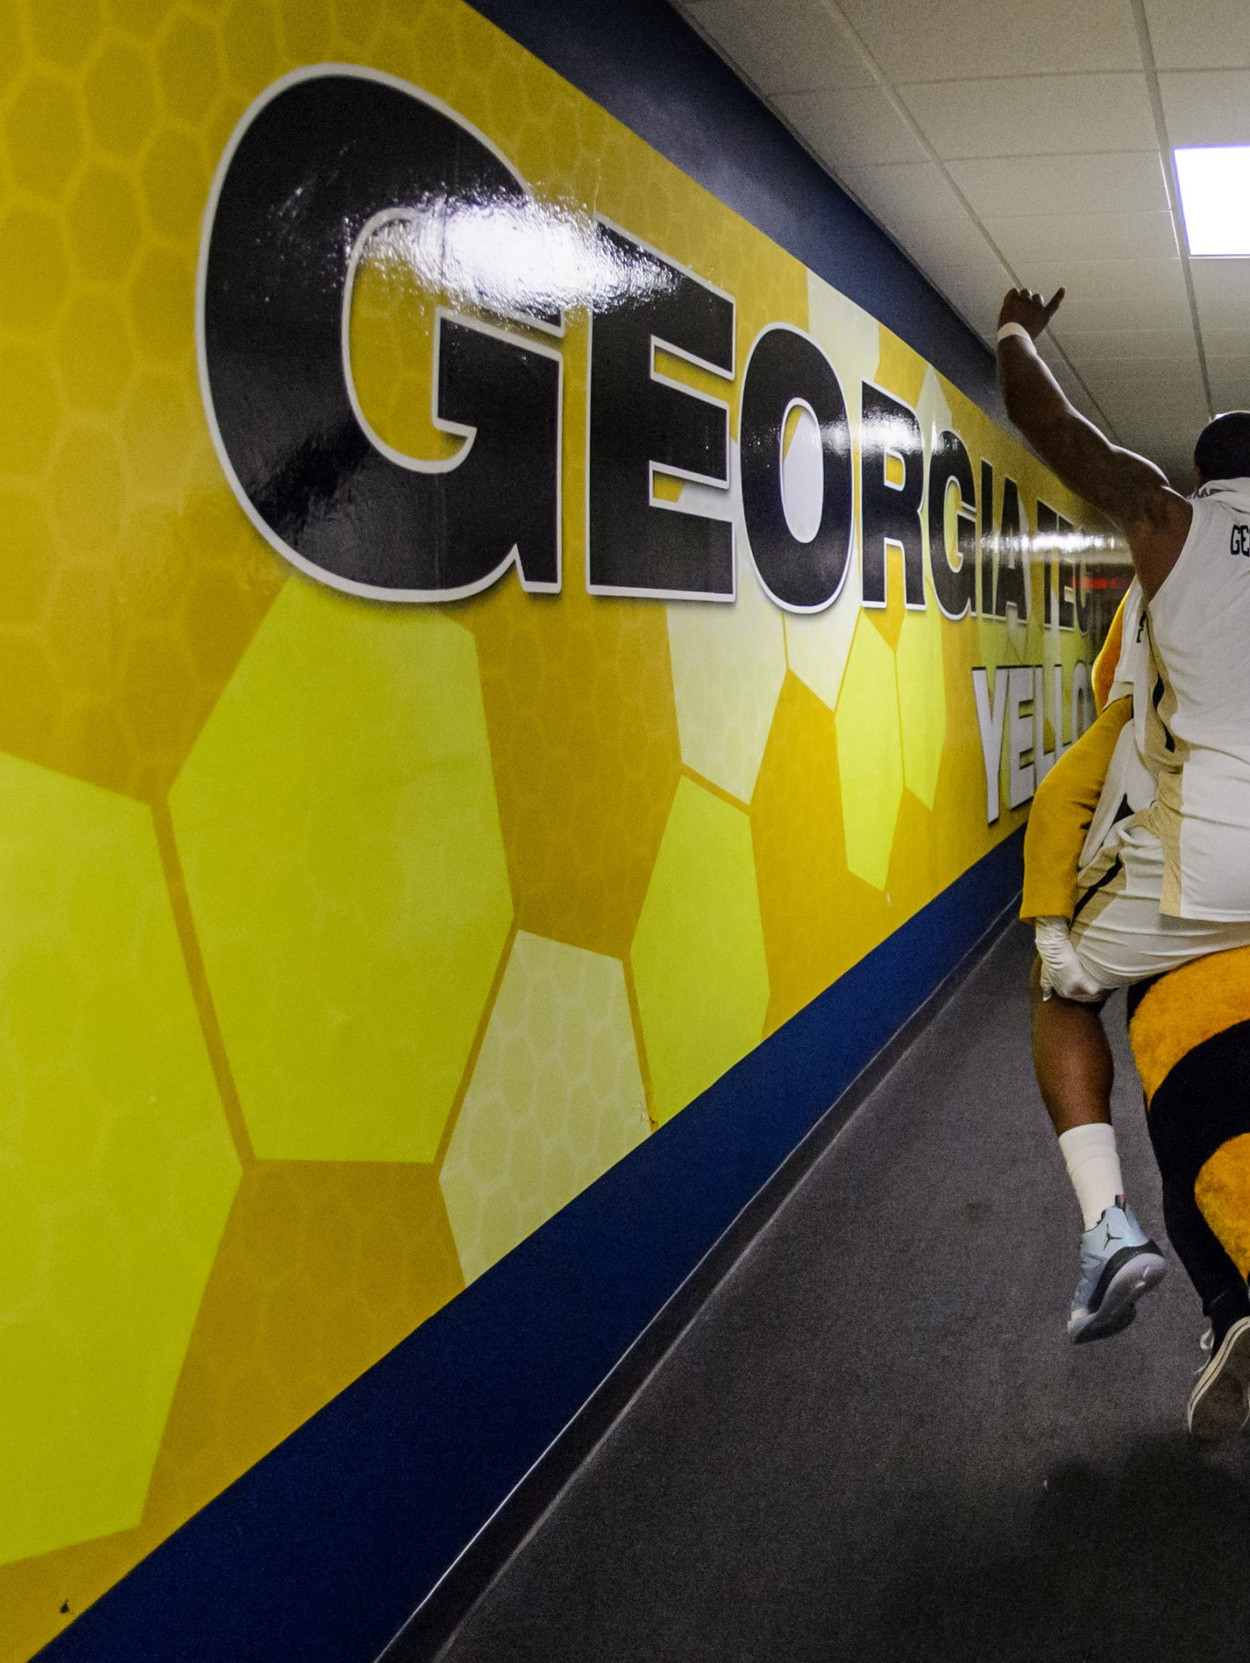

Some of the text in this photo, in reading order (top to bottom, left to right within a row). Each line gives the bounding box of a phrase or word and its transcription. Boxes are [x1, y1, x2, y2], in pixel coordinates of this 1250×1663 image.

[197, 62, 1102, 637] GEORGIA TEC
[972, 660, 1103, 825] YELLO
